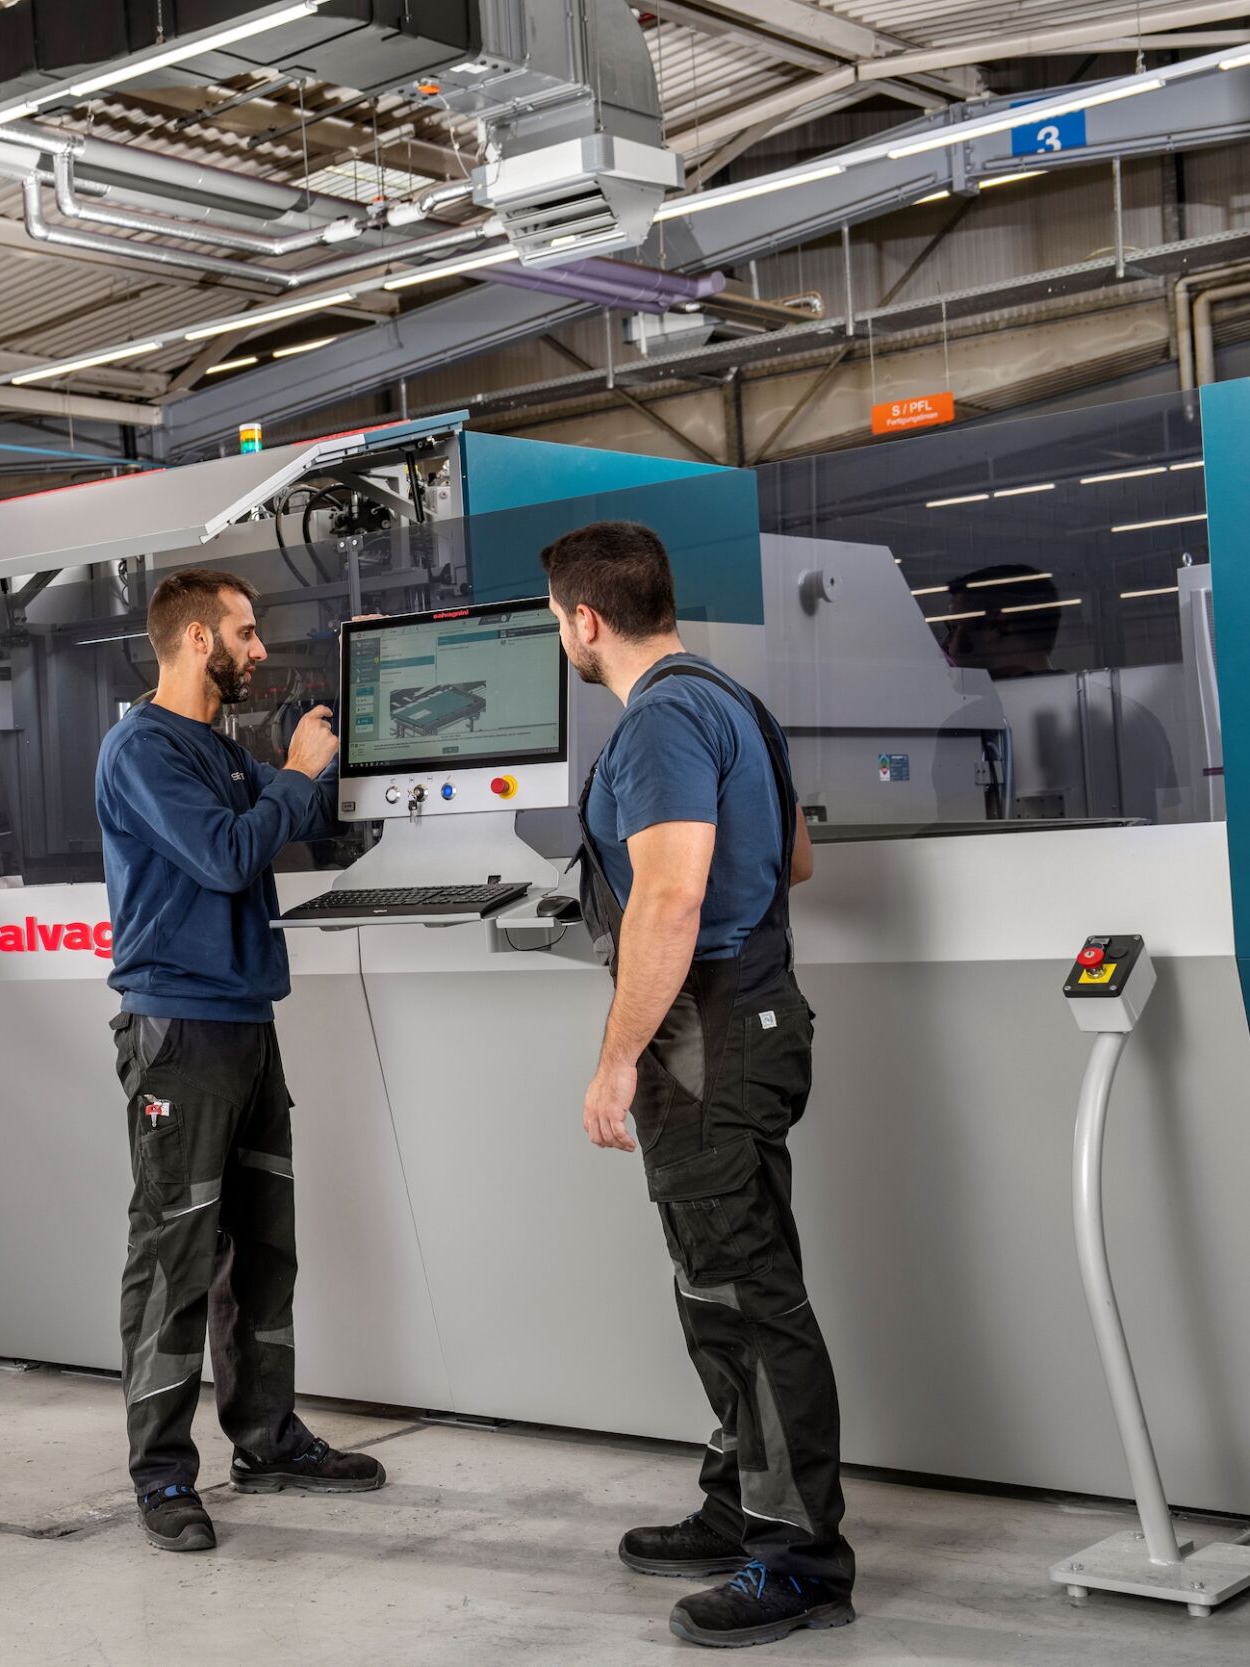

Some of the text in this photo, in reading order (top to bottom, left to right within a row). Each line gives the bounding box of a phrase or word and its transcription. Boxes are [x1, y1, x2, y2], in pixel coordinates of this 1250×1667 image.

[1037, 125, 1062, 153] 3
[891, 405, 901, 417] S
[909, 400, 932, 413] PFL
[433, 609, 469, 619] salvagnini
